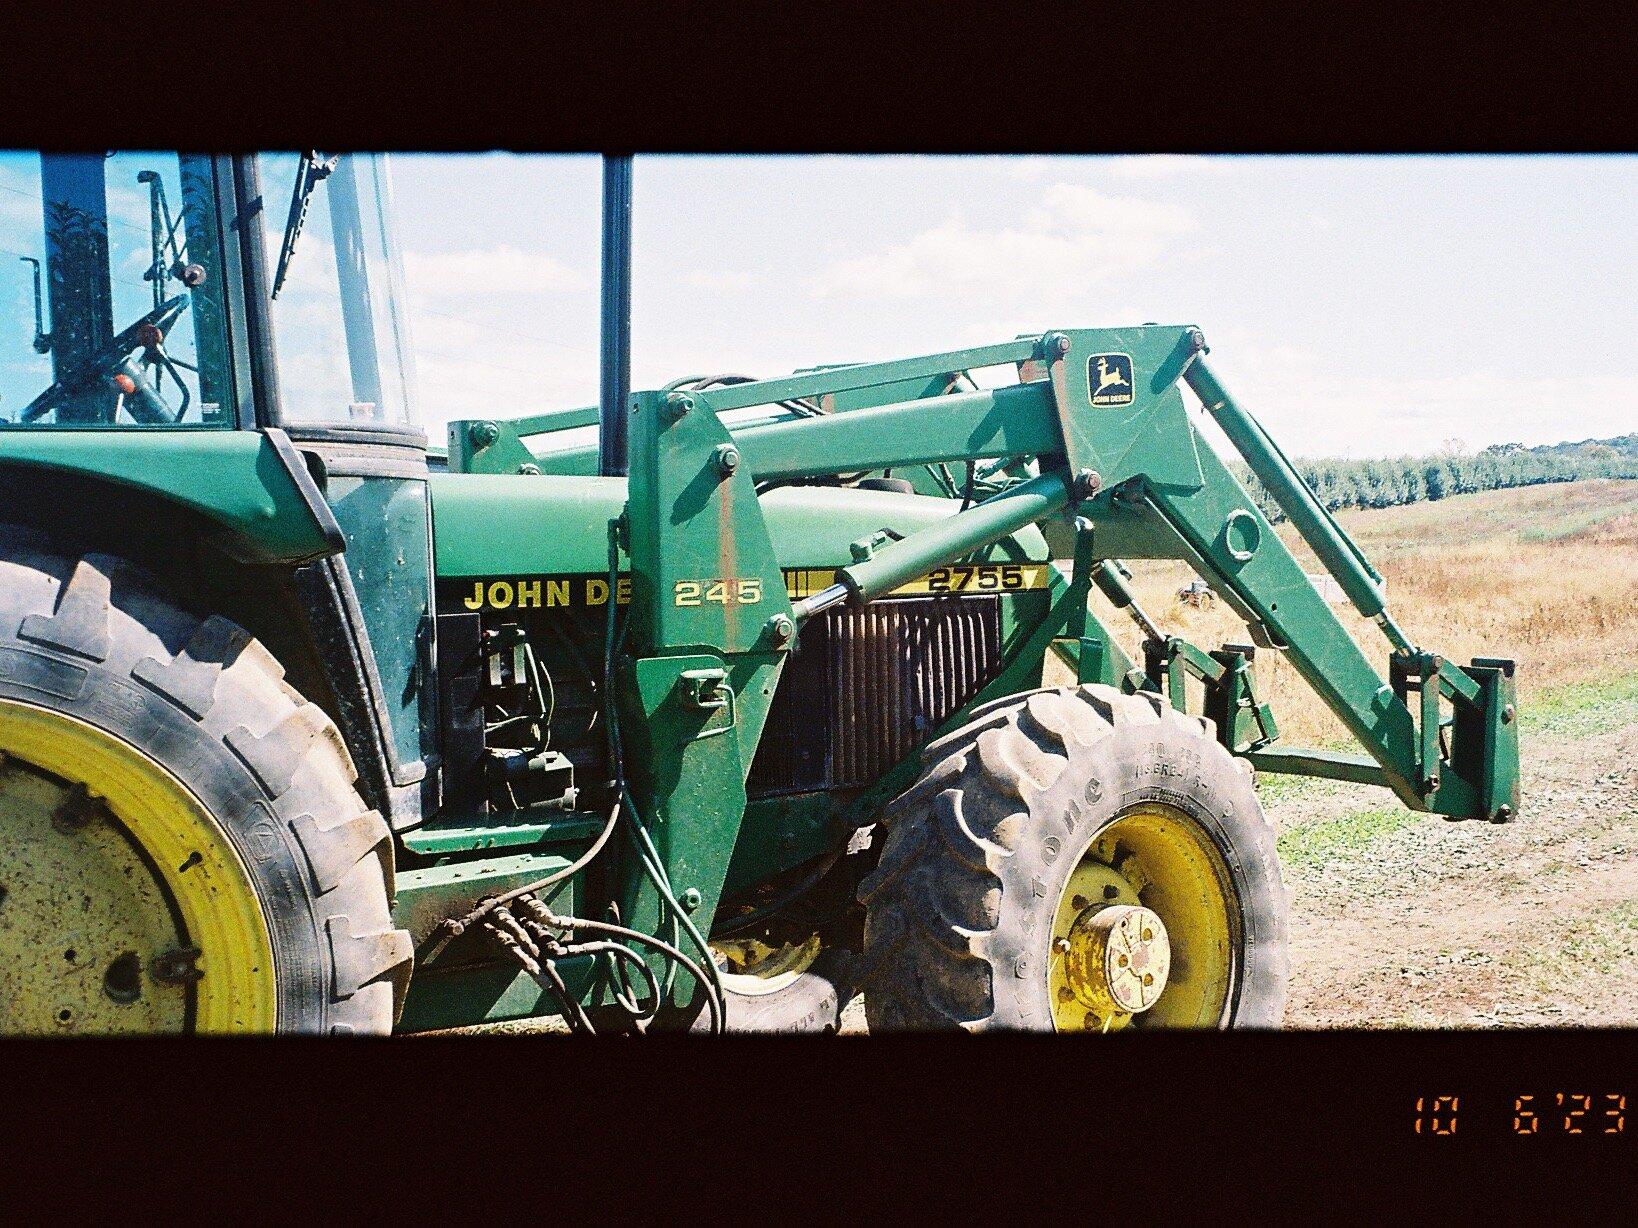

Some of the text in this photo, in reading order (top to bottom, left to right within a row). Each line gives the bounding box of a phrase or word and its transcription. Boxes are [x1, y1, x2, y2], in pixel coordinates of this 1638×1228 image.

[928, 565, 1023, 591] 2755
[463, 580, 571, 610] JOHN
[674, 579, 761, 607] 245
